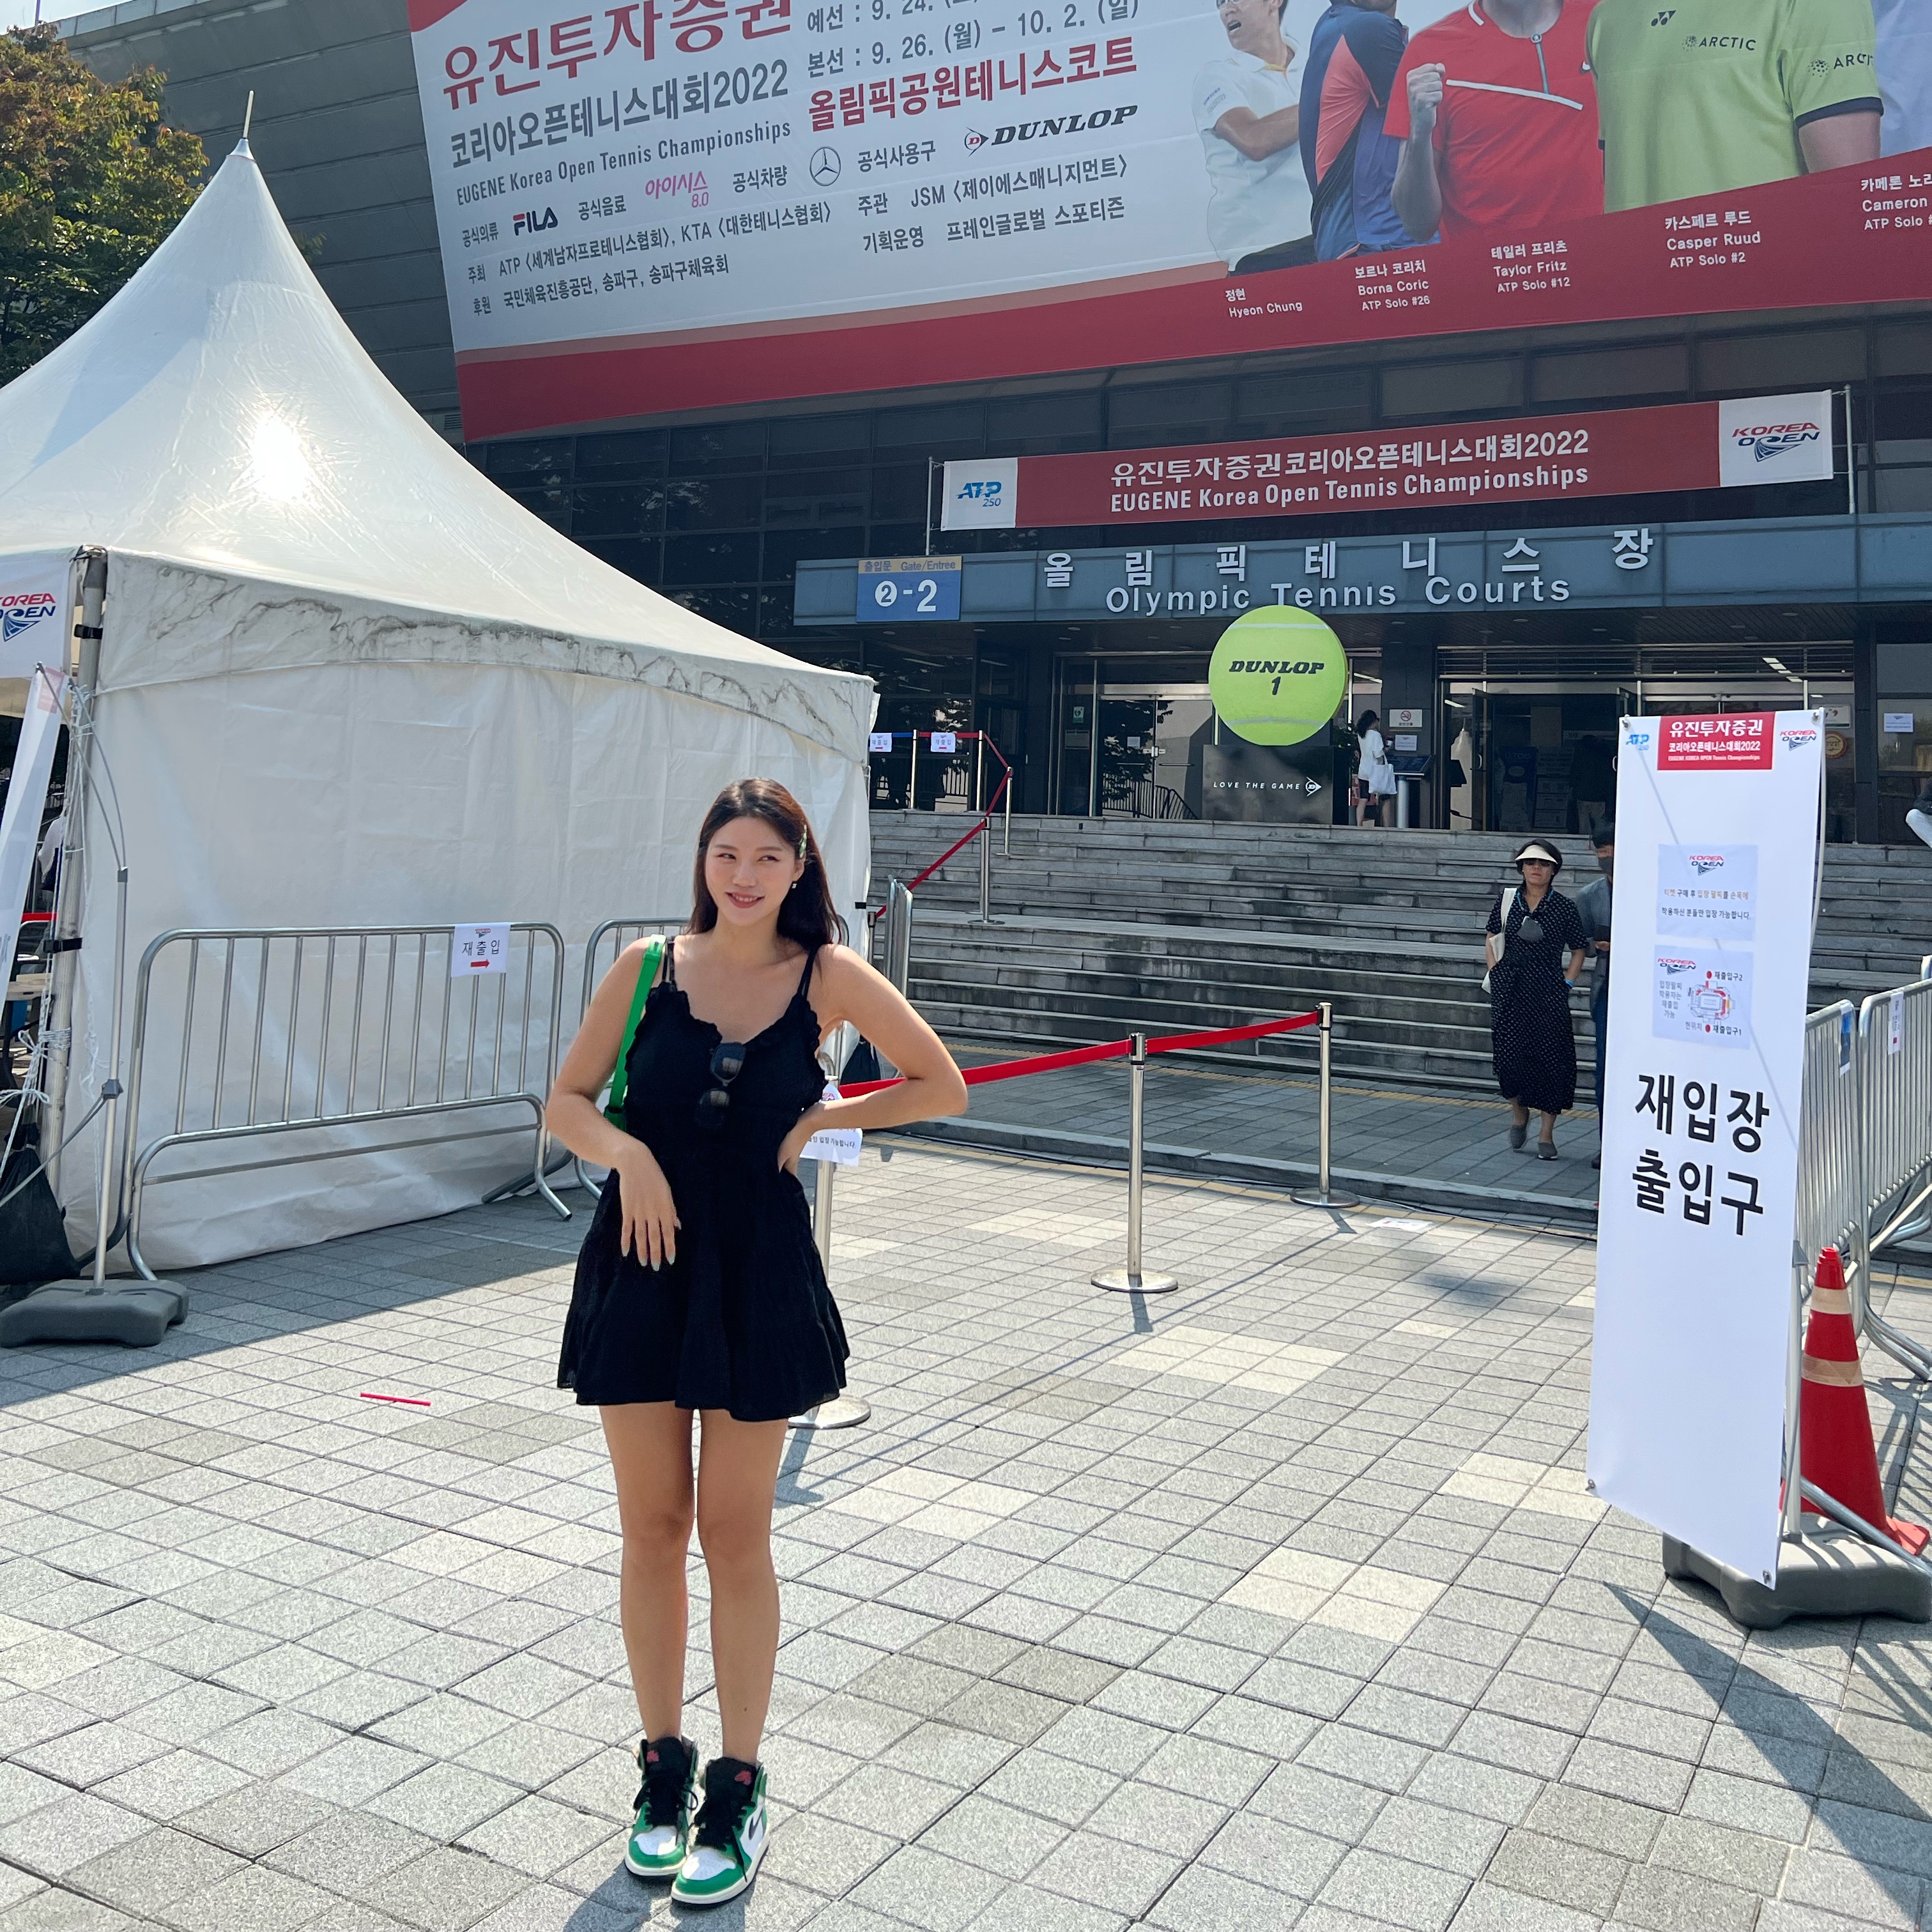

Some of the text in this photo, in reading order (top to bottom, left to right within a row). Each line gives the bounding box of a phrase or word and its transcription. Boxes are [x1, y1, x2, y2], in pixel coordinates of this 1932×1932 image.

[808, 4, 843, 33] 예선
[872, 0, 891, 20] 9.
[808, 47, 843, 78] 본선
[872, 42, 891, 65] 9.
[902, 34, 933, 59] 26.
[945, 19, 981, 54] (월)
[1018, 10, 1052, 36] 10.
[1064, 4, 1085, 28] 2.
[1699, 36, 1756, 51] ARCTIC
[443, 0, 792, 109] 유진투자증권
[809, 36, 1137, 132] 올림픽공원테니스코트
[451, 59, 788, 168] 코리아오픈테니스대회2022
[991, 105, 1138, 146] DUNLOP
[457, 120, 791, 206] EUGENE Korea Open Tennis Championships
[857, 141, 936, 172] 공식사용구
[645, 171, 708, 199] 아이시스
[732, 165, 787, 194] 공식차량
[1861, 176, 1903, 192] 카메론
[578, 195, 627, 221] 공식음료
[691, 193, 709, 208] 8.0
[857, 193, 888, 217] 주관
[910, 185, 946, 208] JSM
[1862, 197, 1928, 212] Cameron
[512, 206, 558, 236] FILA
[863, 196, 1125, 254] 기획운영 프레인글로벌 스포티즌
[1665, 210, 1751, 231] 카스페르 루드
[1864, 218, 1889, 231] ATP
[1894, 216, 1923, 228] Solo
[462, 222, 498, 248] 공식의류
[1666, 231, 1761, 251] Casper Ruud
[468, 265, 486, 284] 주최
[499, 257, 520, 277] ATP
[682, 224, 712, 242] KTA
[1491, 240, 1567, 260] 테일러 프리츠
[1670, 252, 1745, 268] ATP Solo #2
[1355, 259, 1427, 279] 보르나 코리치
[1494, 260, 1567, 279] Taylor Fritz
[473, 254, 729, 316] 후원 국민체육진흥공단, 송파구, 송파구체육회
[1225, 288, 1246, 302] 정현
[1358, 279, 1429, 297] Borna Coric
[1498, 277, 1570, 293] ATP Solo #12
[1229, 300, 1303, 318] Hyeon Chung
[1361, 295, 1430, 311] ATP Solo #26
[1732, 422, 1820, 438] KOREA
[1738, 431, 1820, 446] OPEN
[1111, 429, 1590, 487] 유진투자증권코리아오픈테니스대회2022
[956, 480, 1002, 499] ATP
[1111, 465, 1588, 512] EUGENE Korea Open Tennis Championships
[982, 497, 1001, 507] 250
[864, 561, 891, 572] 출입문
[0, 594, 56, 607] OREA
[1106, 576, 1569, 616] Olympic Tennis Courts
[0, 606, 56, 618] PEN
[1229, 661, 1324, 674] DUNLOP
[1271, 677, 1281, 695] 1
[1669, 719, 1763, 738] 유진투자증권
[1668, 740, 1761, 753] 코리아오픈테니스대회2022
[1705, 909, 1717, 918] 입장
[1635, 1074, 1770, 1153] 재입장
[1632, 1149, 1763, 1236] 출입구
